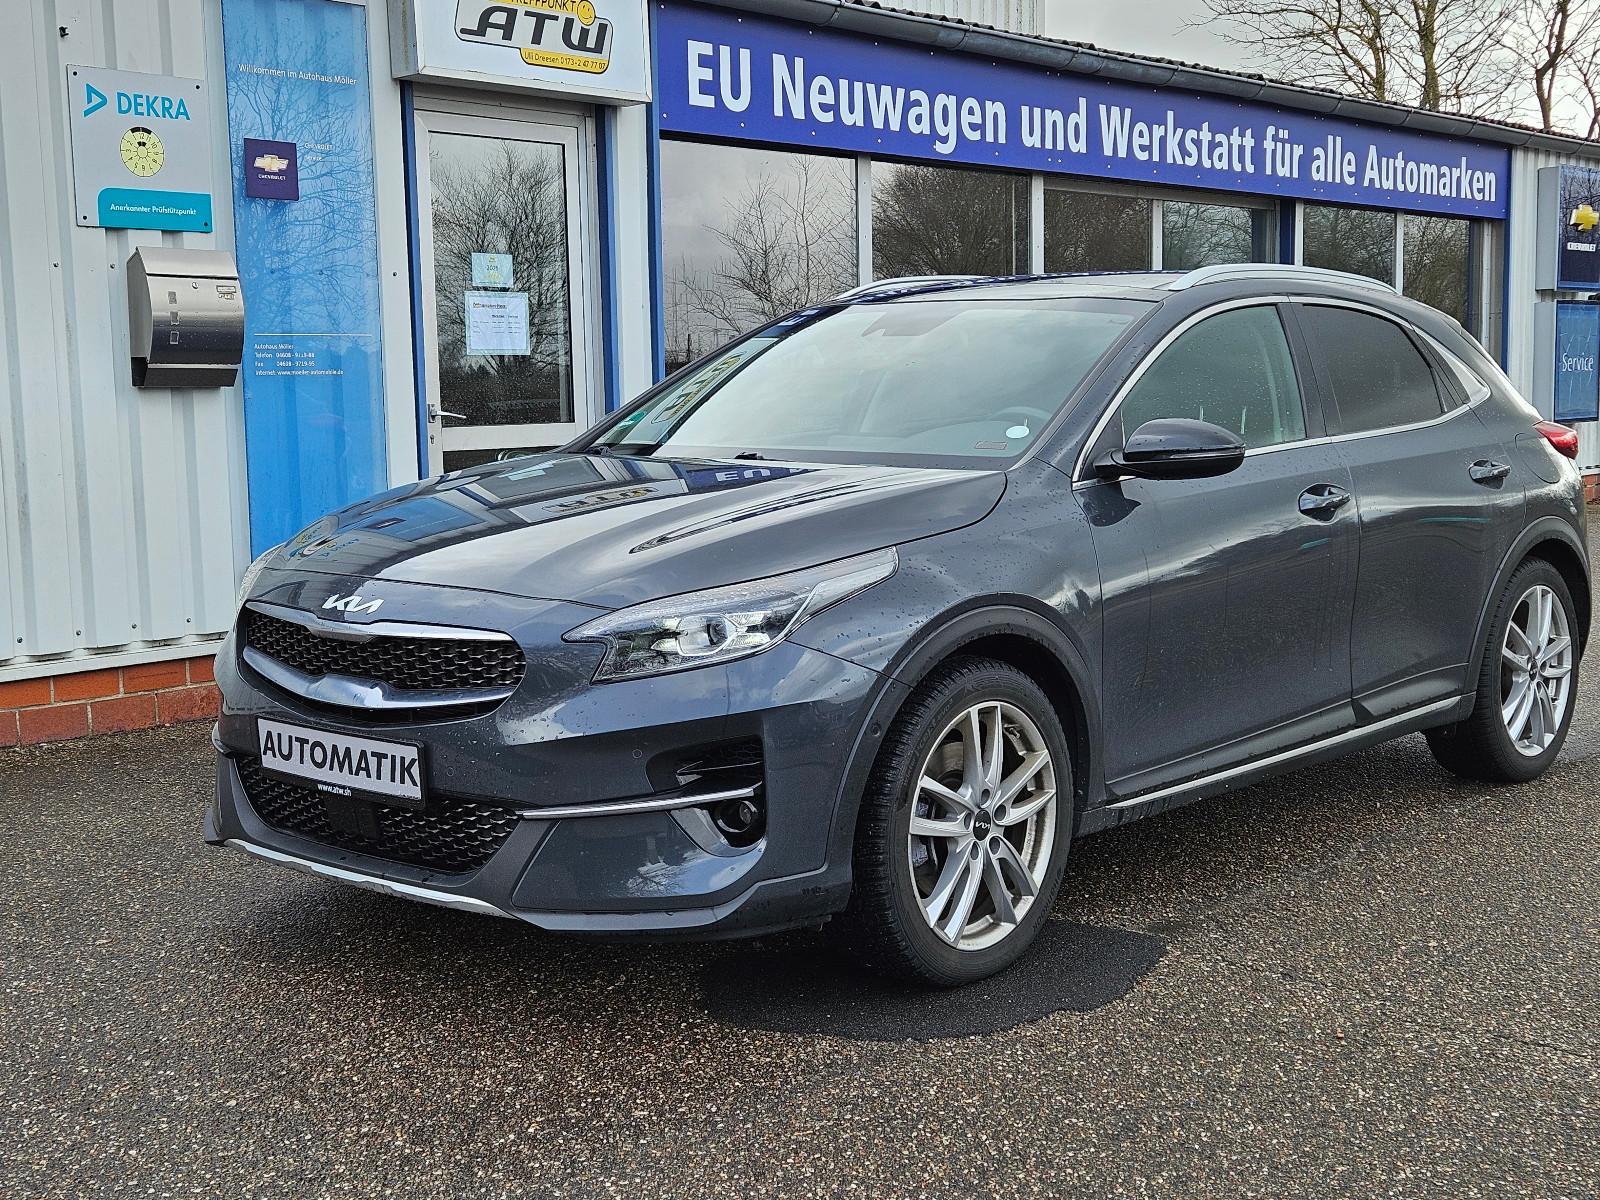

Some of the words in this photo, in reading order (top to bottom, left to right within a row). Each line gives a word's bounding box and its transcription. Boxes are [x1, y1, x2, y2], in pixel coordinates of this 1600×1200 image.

[459, 5, 609, 55] ATW
[534, 53, 559, 63] Dreesen
[238, 63, 286, 78] Willkommen
[287, 69, 297, 78] im
[298, 71, 333, 83] Autohaus
[333, 75, 358, 86] Möller
[116, 91, 191, 121] DEKRA
[687, 40, 751, 113] EU
[772, 53, 1007, 155] Neuwagen
[1020, 96, 1087, 154] und
[1099, 103, 1255, 174] Werkstatt
[1263, 125, 1304, 179] für
[1311, 134, 1356, 186] alle
[1363, 144, 1496, 202] Automarken
[110, 203, 151, 213] Anerkannter
[151, 205, 197, 217] Prüfstützpunkt
[1561, 351, 1594, 373] Service
[262, 730, 420, 788] AUTOMATIK
